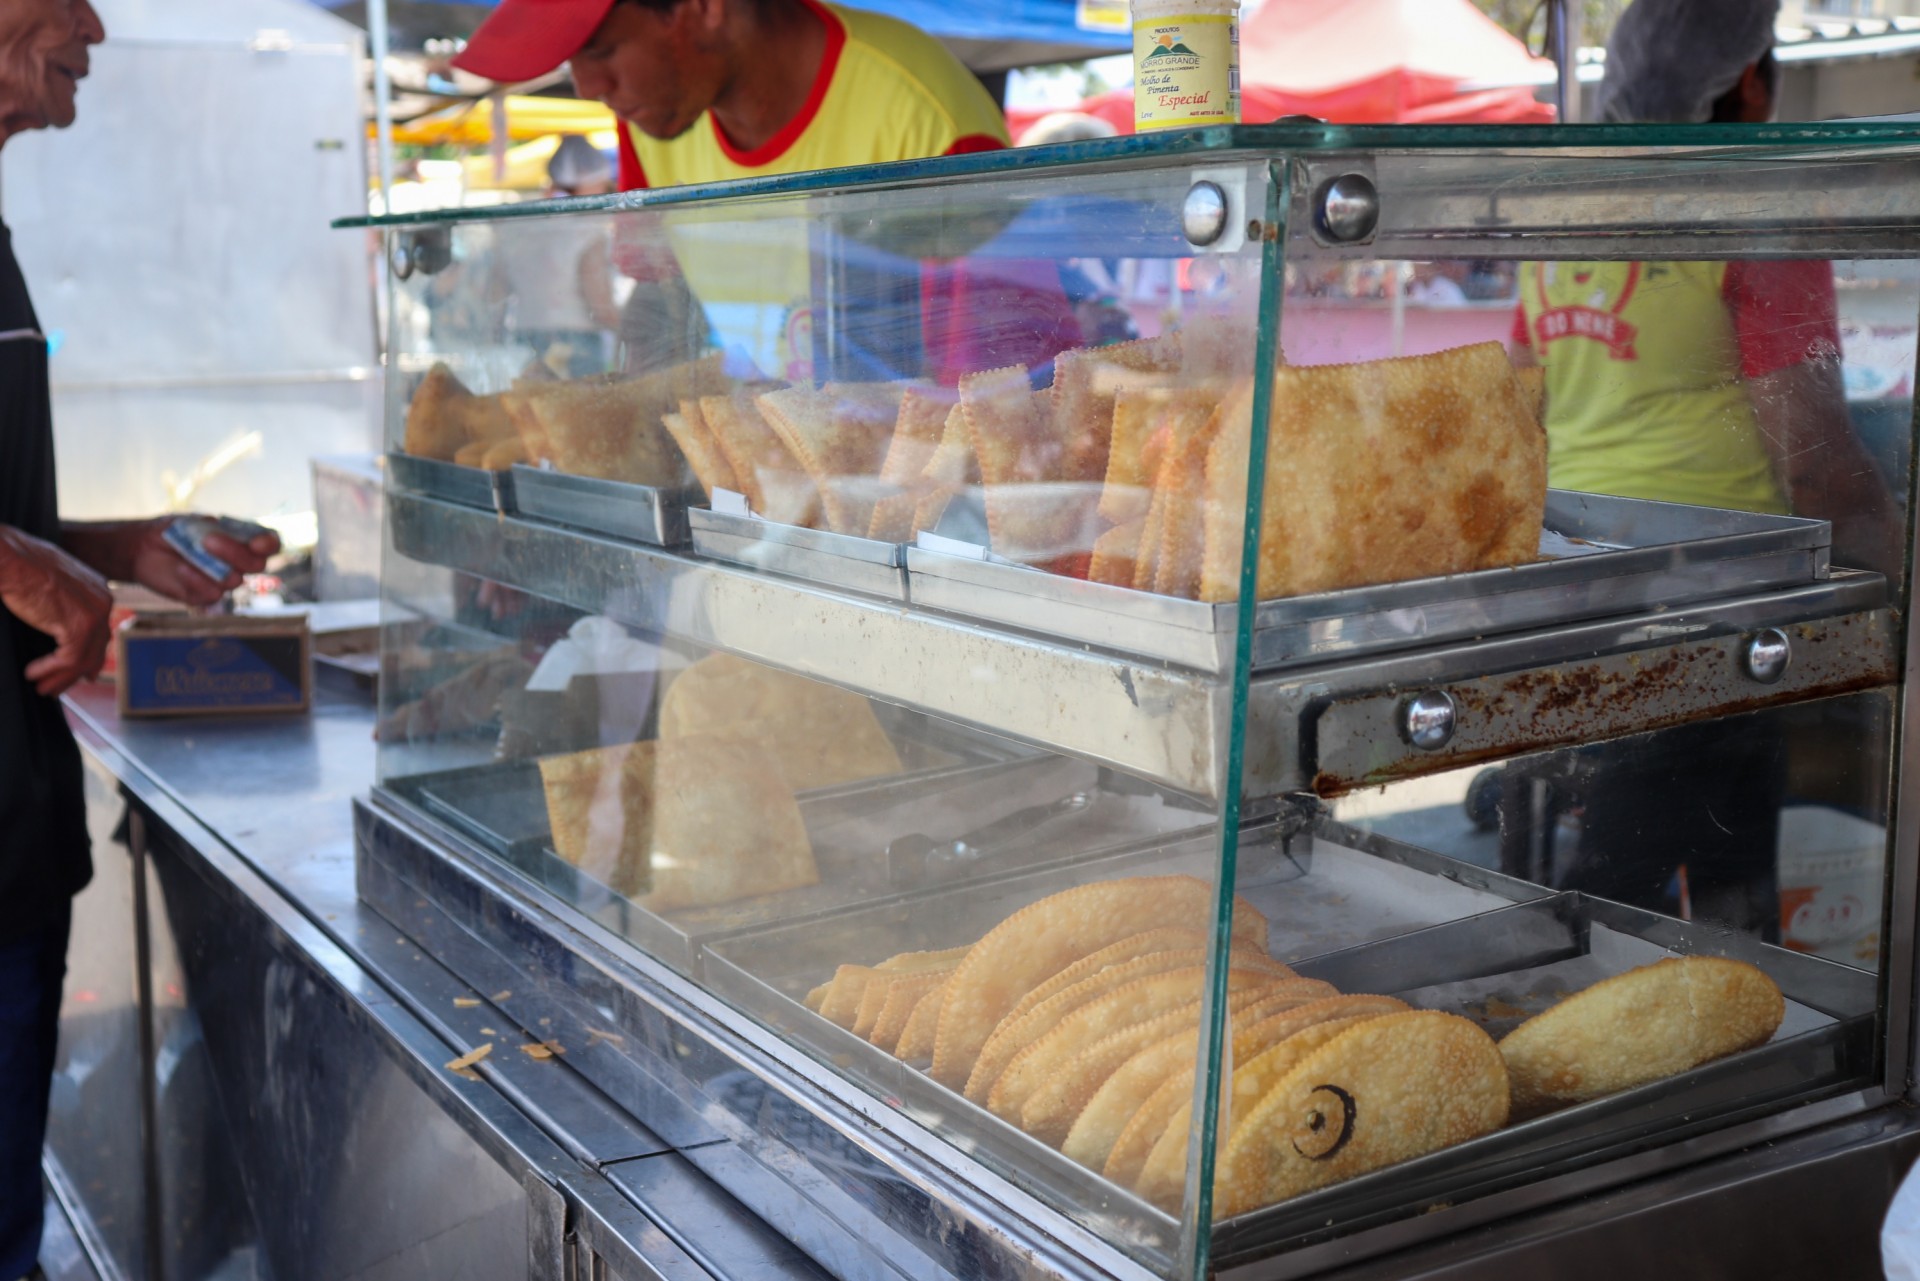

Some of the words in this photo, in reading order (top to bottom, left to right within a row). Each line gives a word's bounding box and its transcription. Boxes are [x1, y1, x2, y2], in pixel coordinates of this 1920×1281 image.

[1141, 58, 1163, 69] MORRO
[1165, 57, 1200, 65] GRANDE
[1140, 75, 1160, 86] Molho
[1162, 74, 1171, 84] de
[1147, 85, 1179, 95] Pimenta
[1158, 91, 1209, 110] Especial
